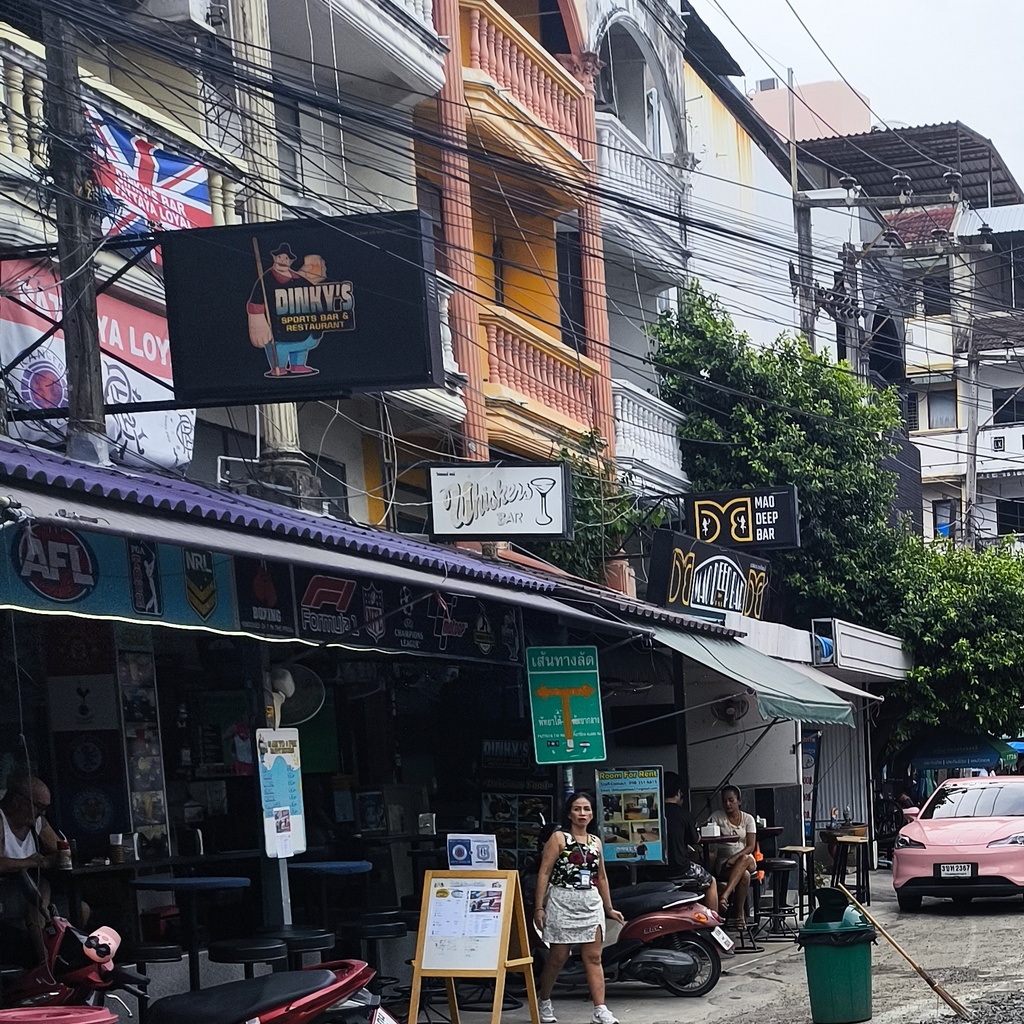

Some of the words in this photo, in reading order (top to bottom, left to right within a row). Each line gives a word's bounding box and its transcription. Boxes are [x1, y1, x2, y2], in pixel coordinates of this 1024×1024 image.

[274, 283, 353, 315] DINKY'S
[281, 314, 317, 325] SPORTS
[320, 313, 339, 322] BAR
[342, 311, 349, 320] &
[286, 321, 345, 332] RESTAURANT
[440, 479, 534, 529] Whiskers
[754, 495, 775, 509] MAO
[496, 511, 524, 527] BAR
[755, 511, 779, 525] DEEP
[756, 527, 775, 541] BAR
[20, 537, 95, 586] AFL
[185, 550, 213, 574] NRL
[531, 651, 594, 667] เส้นทางลัด
[600, 772, 622, 780] Room
[638, 769, 657, 778] Rent
